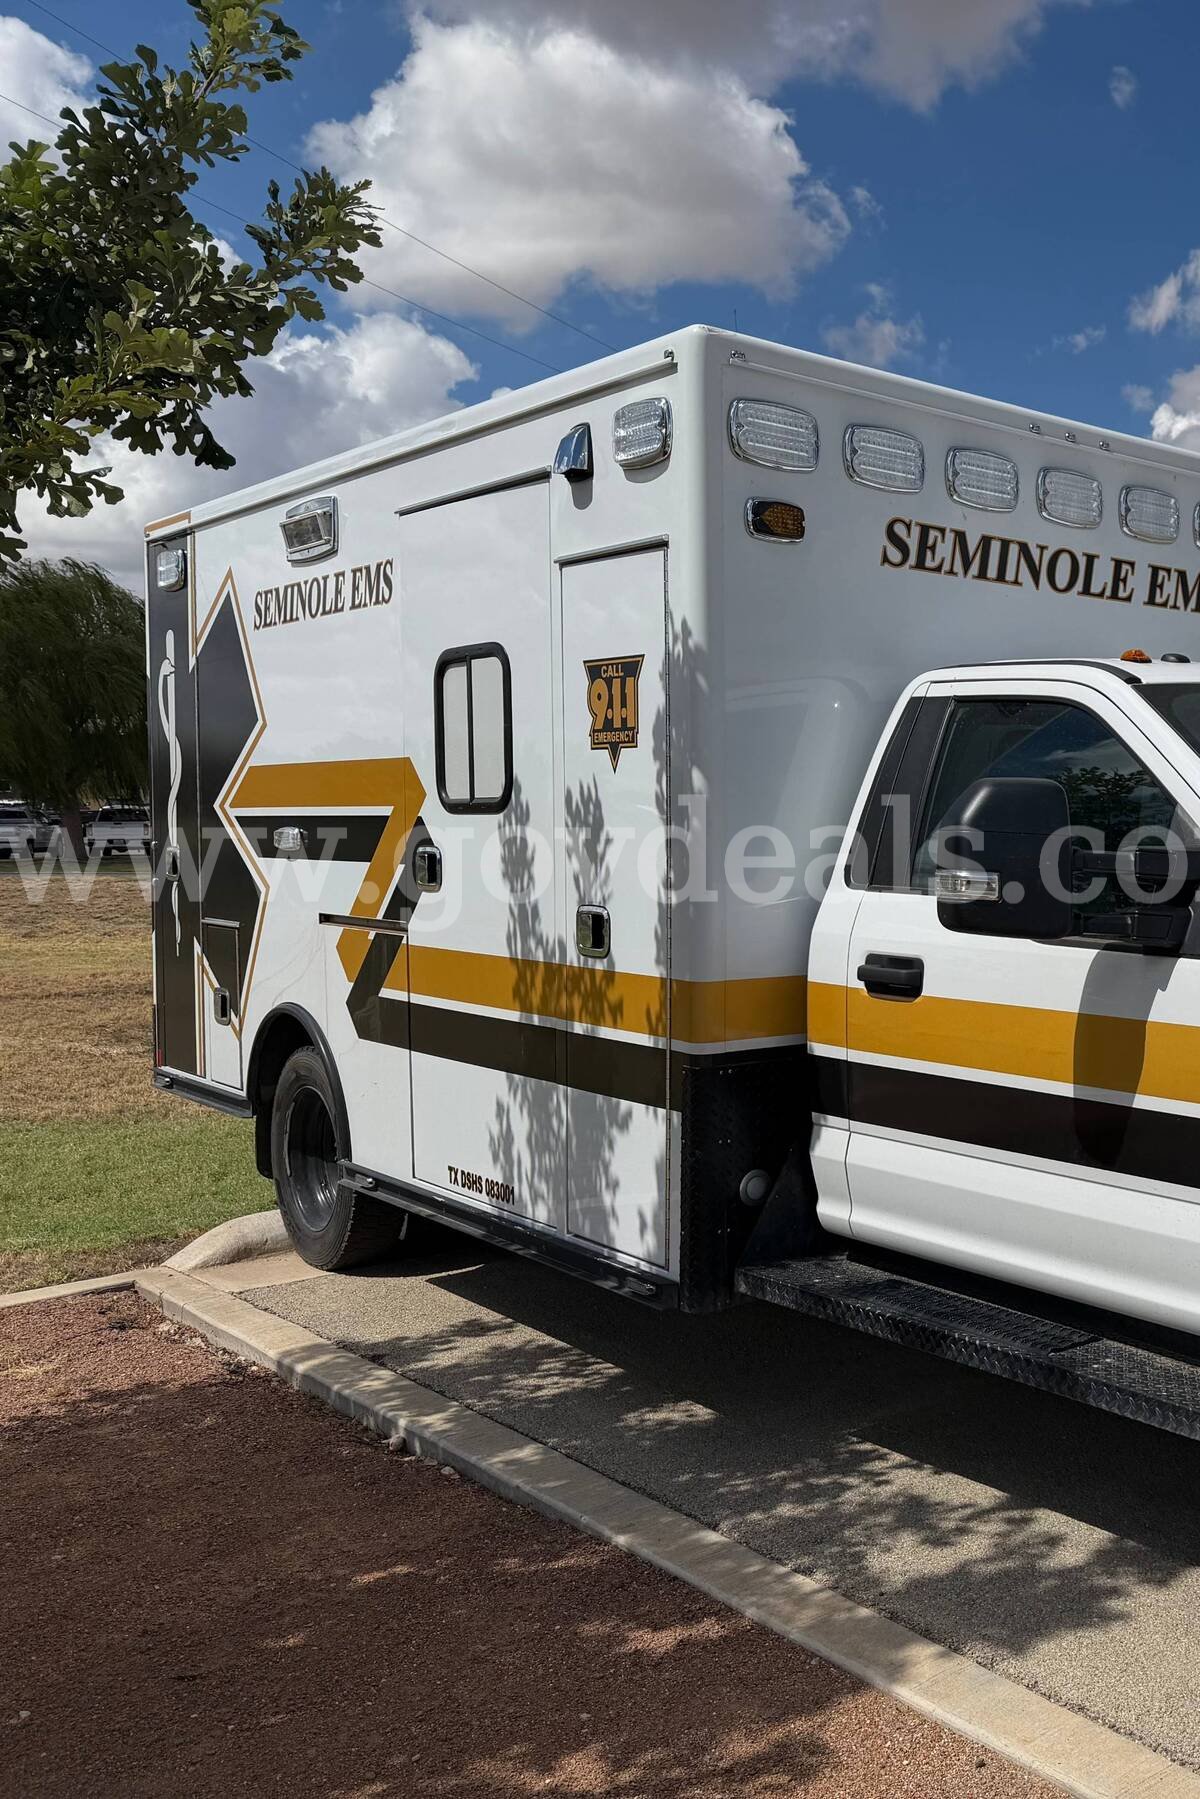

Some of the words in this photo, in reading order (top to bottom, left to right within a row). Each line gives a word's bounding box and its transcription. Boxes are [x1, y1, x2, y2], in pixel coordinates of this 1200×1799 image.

[880, 515, 1136, 603] SEMINOLE
[253, 569, 346, 632] SEMINOLE
[349, 557, 394, 610] EMS
[601, 663, 624, 677] CALL
[594, 731, 633, 743] EMERGENCY
[447, 1165, 459, 1187] TX
[460, 1169, 483, 1194] DSHS
[485, 1177, 515, 1206] 083001
